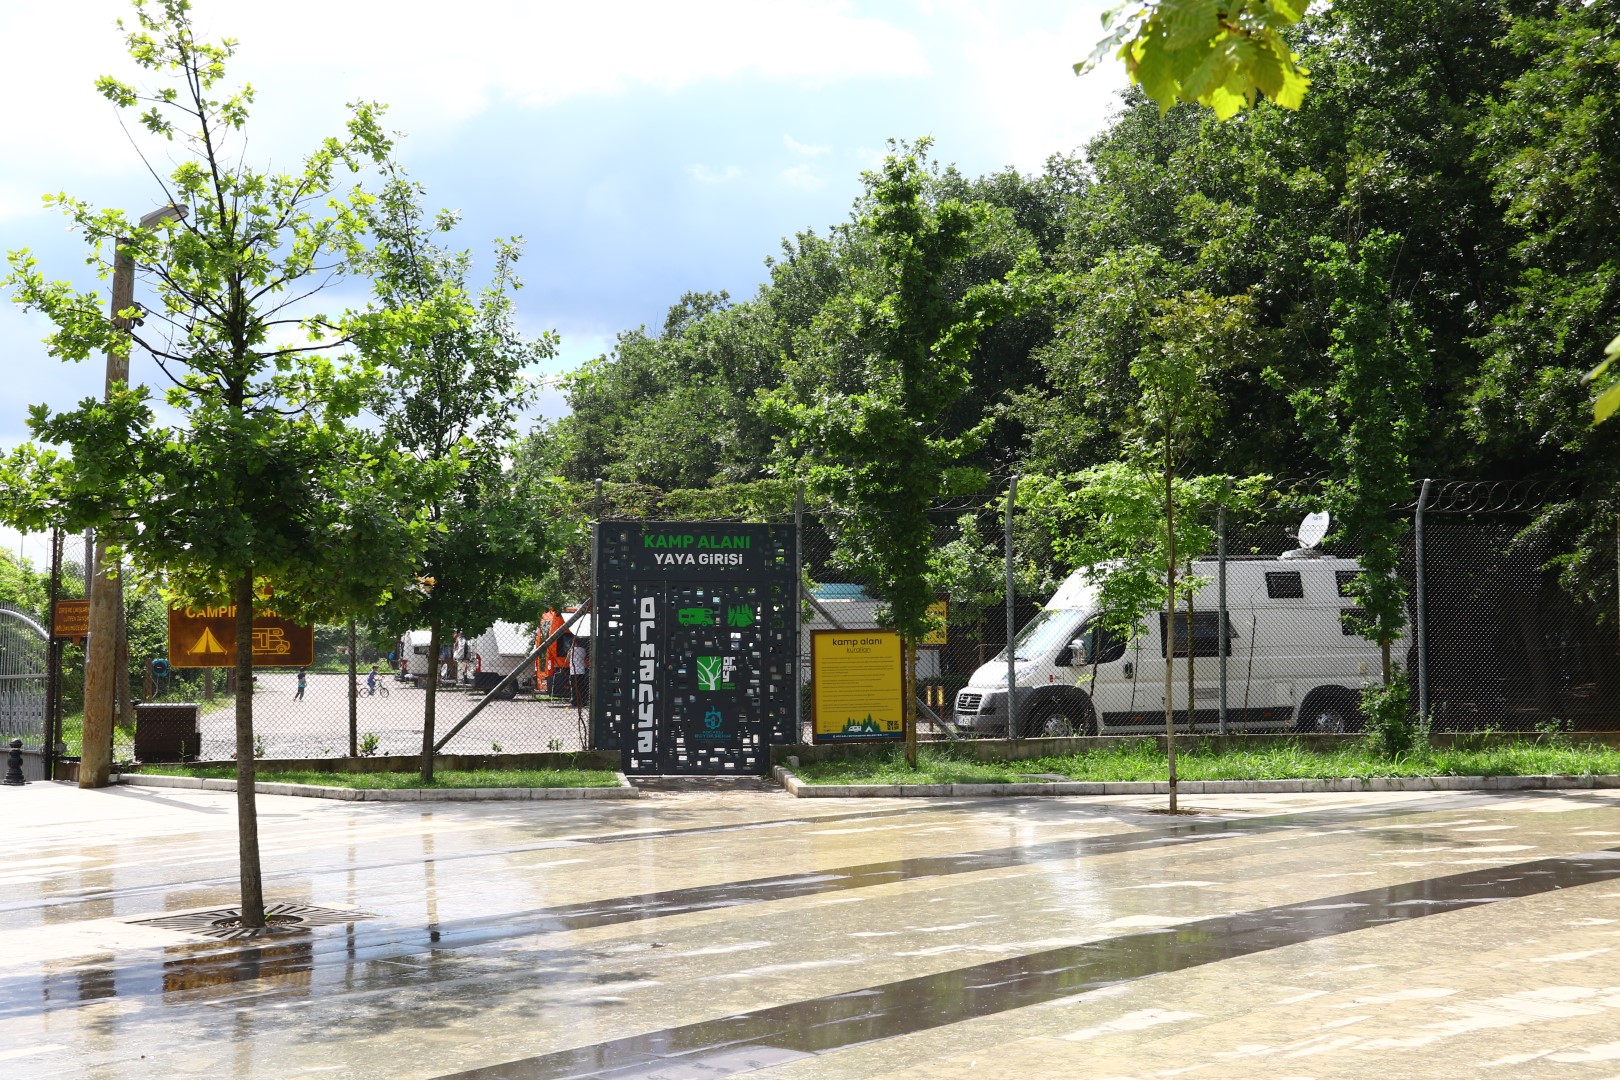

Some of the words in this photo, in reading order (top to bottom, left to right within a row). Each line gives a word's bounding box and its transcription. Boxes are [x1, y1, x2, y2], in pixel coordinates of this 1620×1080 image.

[644, 534, 694, 548] KAMP
[697, 535, 751, 549] ALANI
[654, 553, 696, 565] YAYA
[832, 638, 858, 647] kamp
[860, 637, 882, 645] alanı
[637, 596, 656, 753] ormanya
